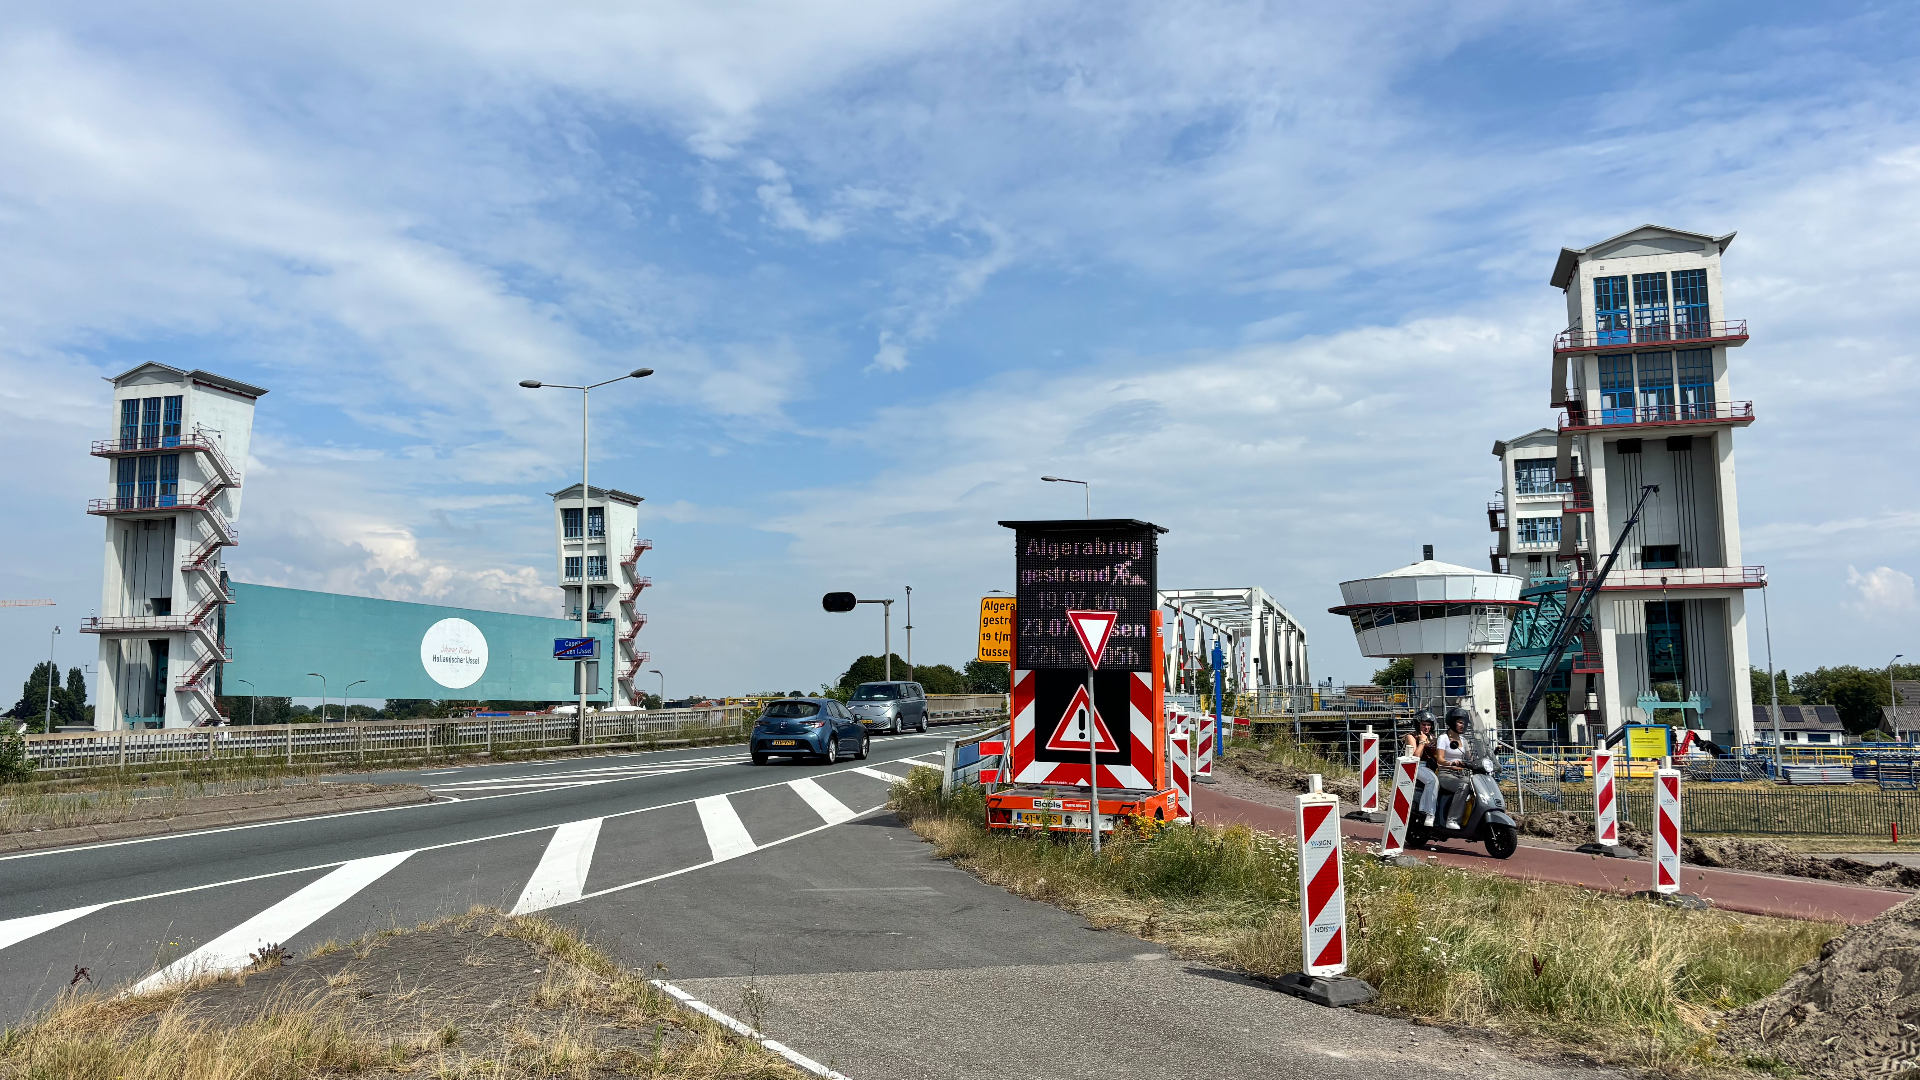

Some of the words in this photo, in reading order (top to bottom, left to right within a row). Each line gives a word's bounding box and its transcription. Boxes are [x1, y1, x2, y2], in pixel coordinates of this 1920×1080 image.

[1025, 537, 1142, 561] Algerabrug
[1021, 566, 1110, 586] gestremd
[981, 632, 991, 641] 19
